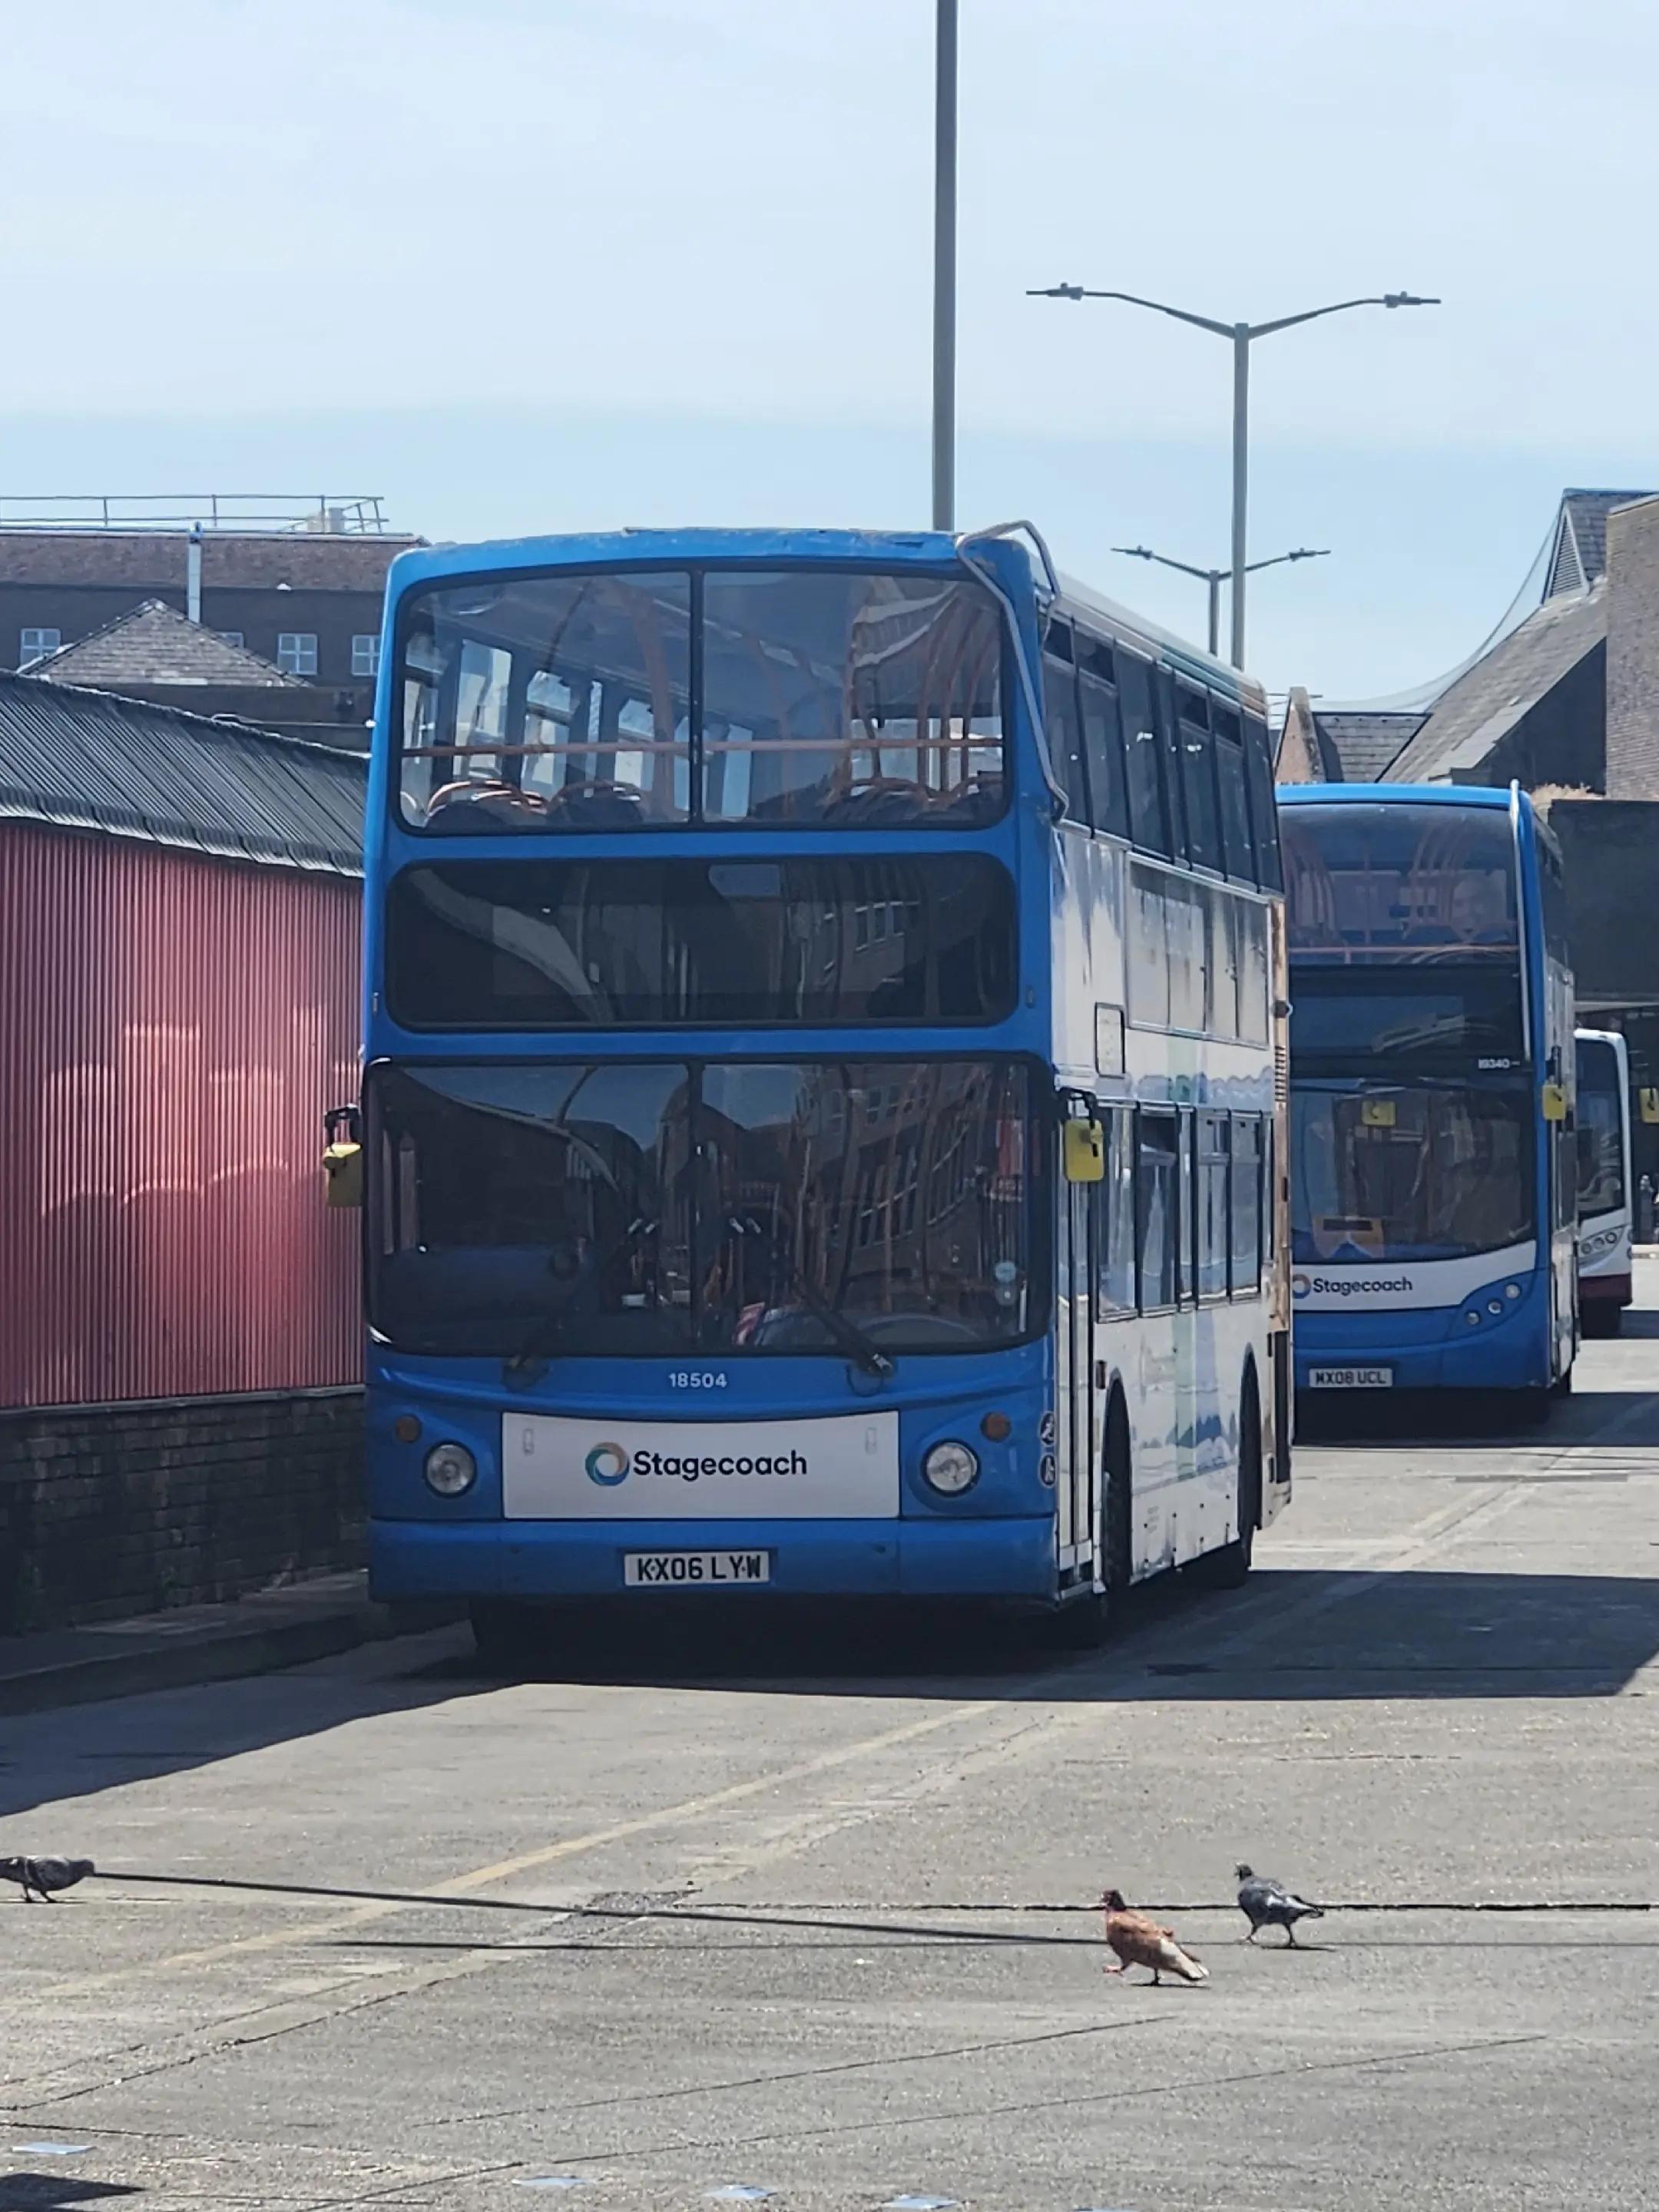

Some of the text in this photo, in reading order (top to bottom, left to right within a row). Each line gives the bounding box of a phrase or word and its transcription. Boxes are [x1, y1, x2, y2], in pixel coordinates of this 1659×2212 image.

[1313, 1276, 1412, 1296] Stagecoach
[668, 1373, 727, 1388] 18504
[1316, 1371, 1386, 1385] MX08 UCL
[633, 1449, 807, 1482] Stagecoach
[637, 1555, 761, 1581] KX06 LYW
